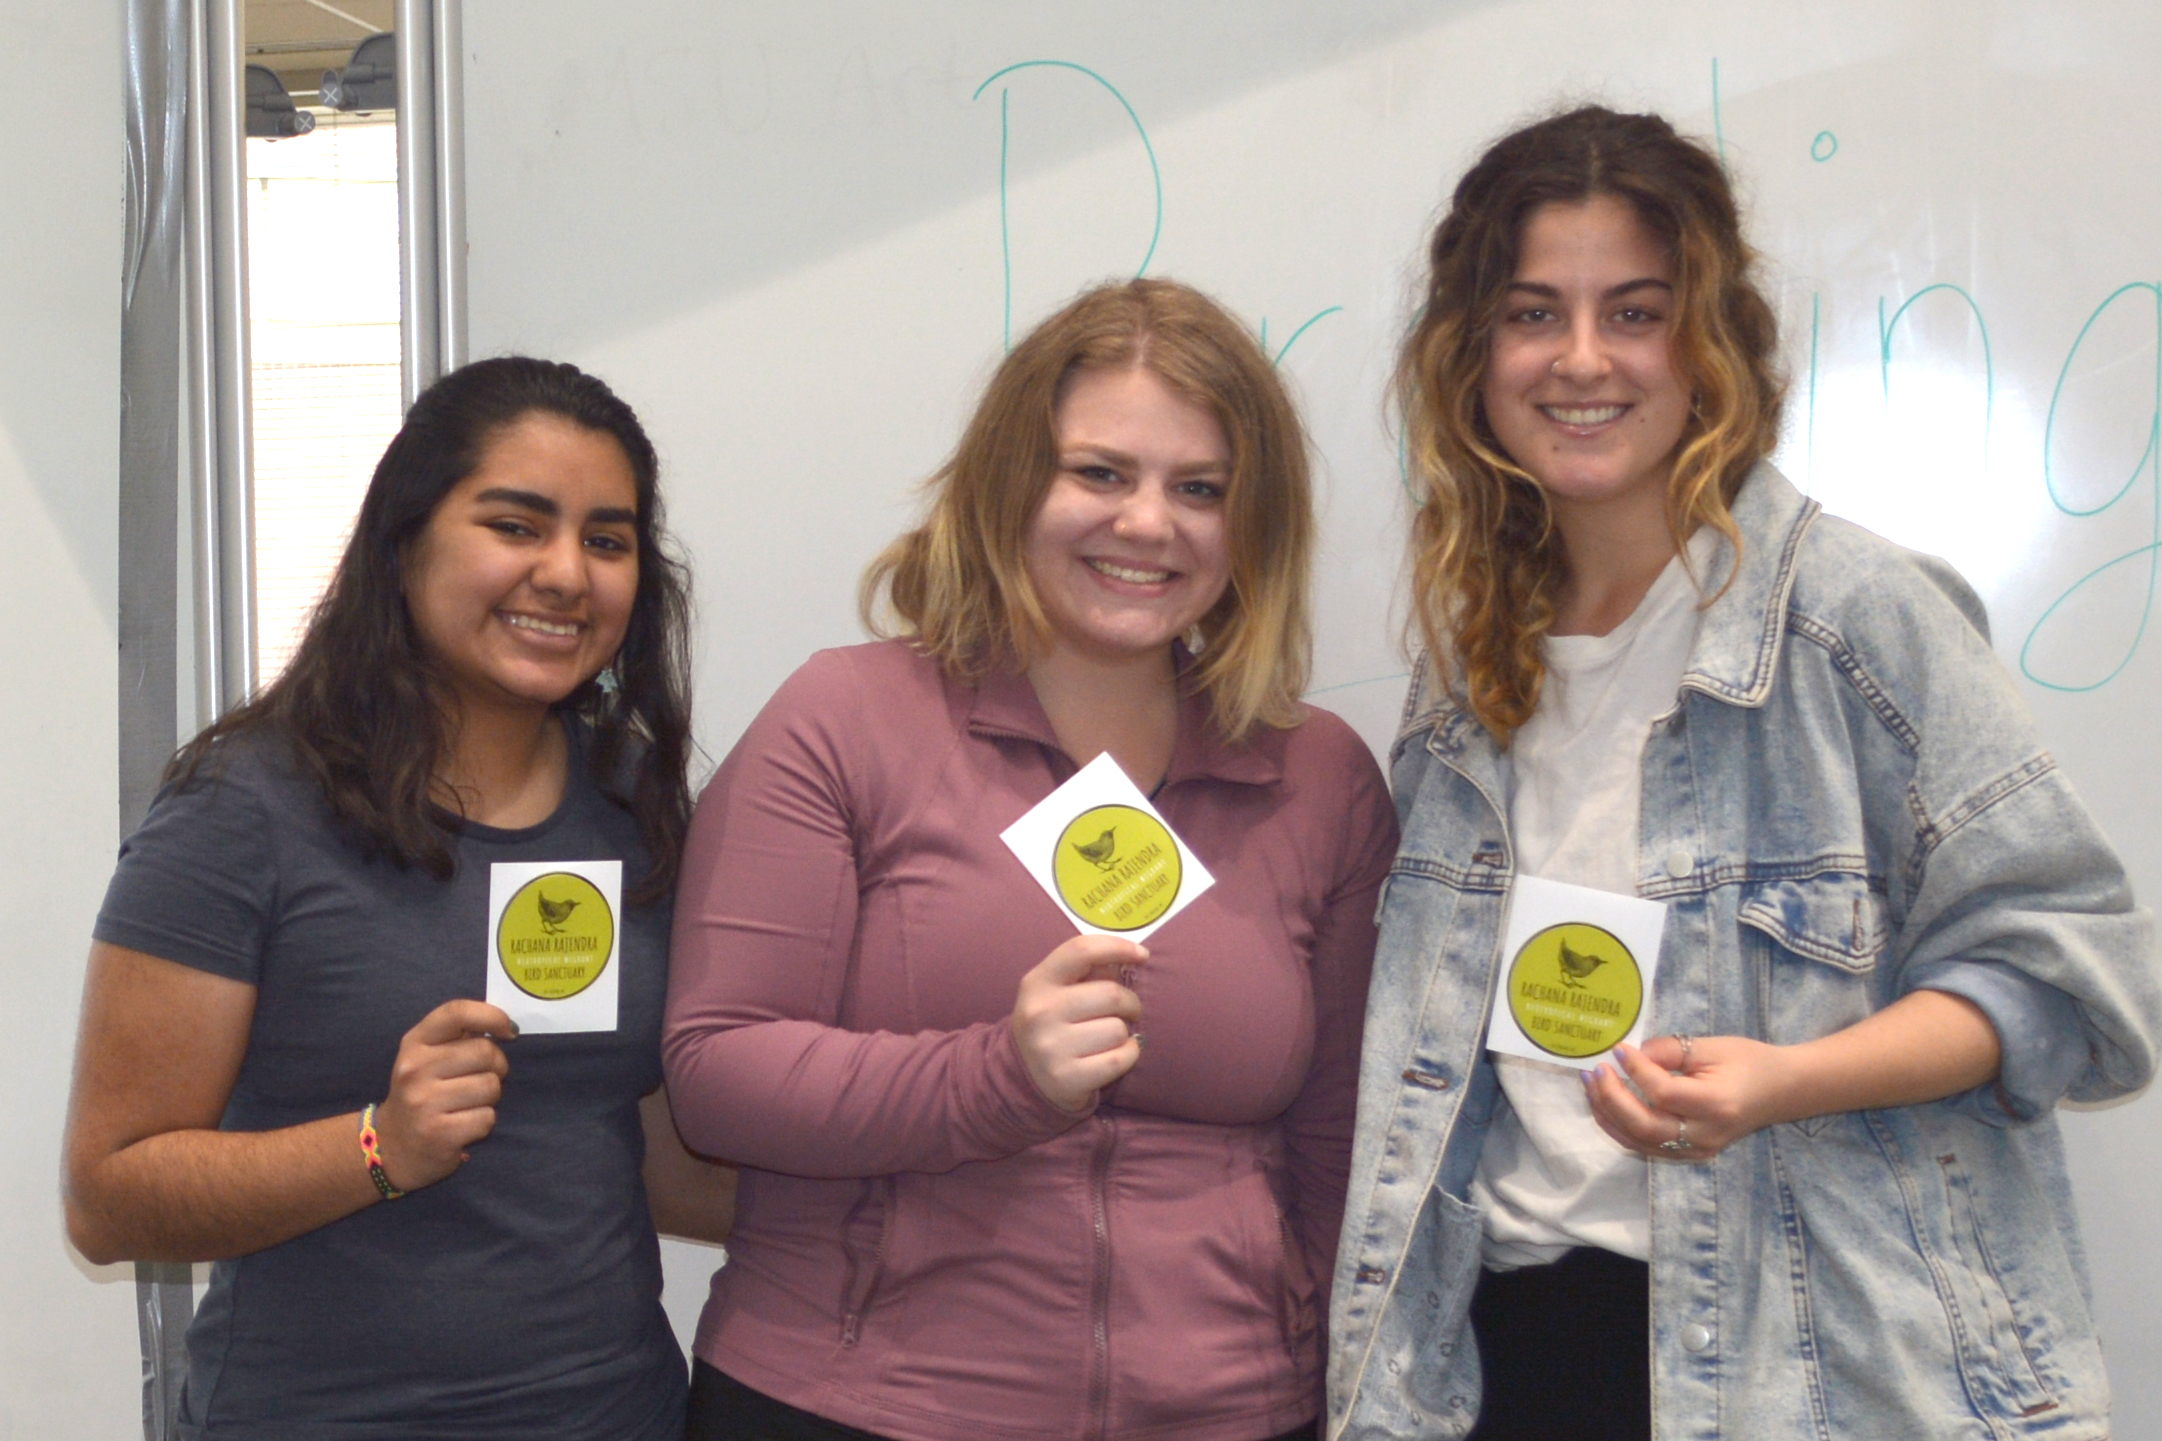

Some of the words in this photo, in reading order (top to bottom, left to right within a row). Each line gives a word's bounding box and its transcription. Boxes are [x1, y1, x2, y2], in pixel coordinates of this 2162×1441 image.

[1082, 874, 1122, 909] RACHANA
[1118, 842, 1162, 880] RAJENDRA
[1114, 905, 1133, 921] BIRD
[1134, 874, 1170, 905] SANCTUARY
[511, 937, 551, 954] RACHANA
[554, 937, 597, 954] RAJENDRA
[524, 968, 540, 981] BIRD
[544, 967, 585, 980] SANCTUARY
[1521, 982, 1567, 1002] RACHANA
[1571, 991, 1620, 1014] RAJENDRA
[1531, 1016, 1550, 1031] BIRD
[1554, 1020, 1602, 1041] SANCTUARY
